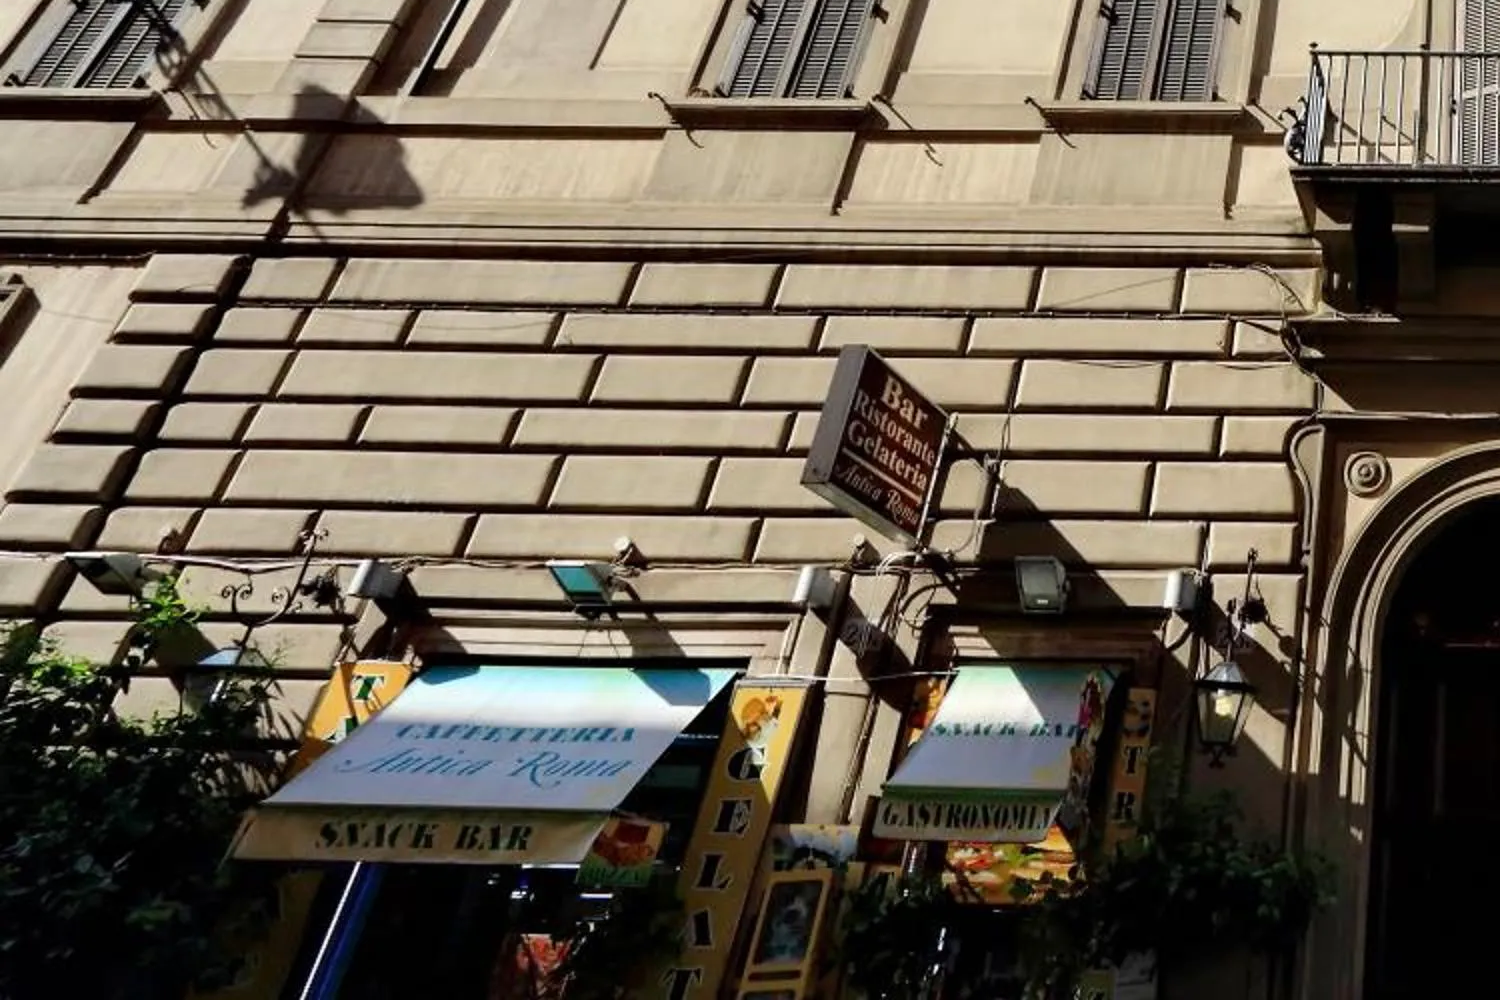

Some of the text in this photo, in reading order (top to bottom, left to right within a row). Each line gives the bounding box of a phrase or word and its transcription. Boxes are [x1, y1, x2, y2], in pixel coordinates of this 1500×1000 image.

[881, 375, 928, 430] Bar
[854, 389, 935, 466] Ristorante
[848, 420, 927, 491] Gelateria
[835, 463, 920, 526] Antica Roma
[396, 723, 636, 743] CAFFETTERIA
[334, 747, 633, 788] Antica Roma
[315, 820, 535, 851] SNACK BAR
[881, 801, 1051, 831] GASTRONOMIA
